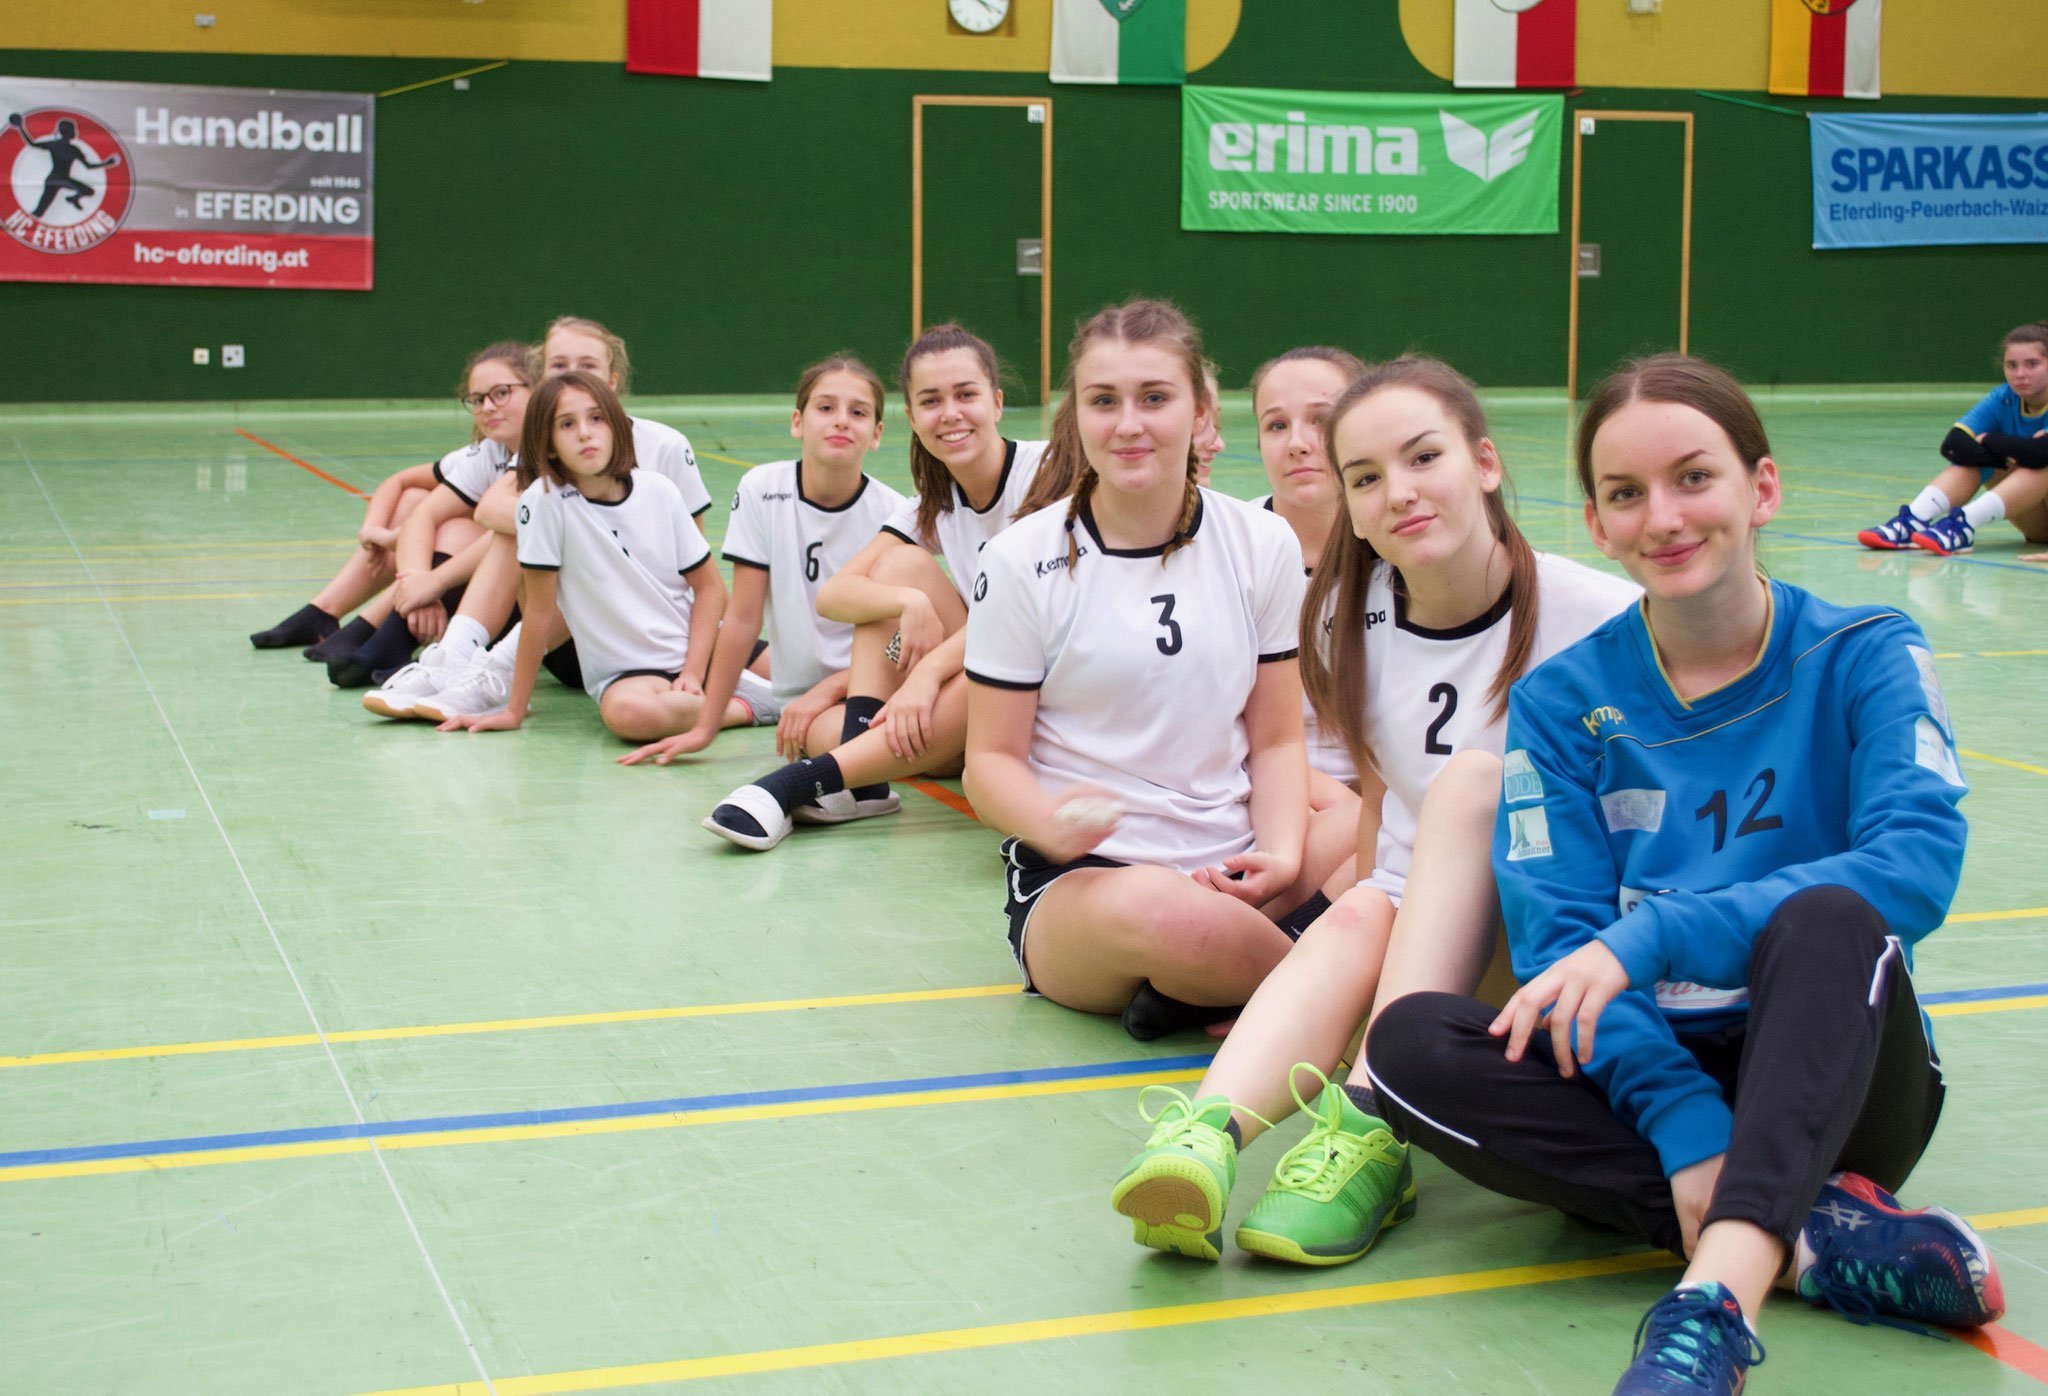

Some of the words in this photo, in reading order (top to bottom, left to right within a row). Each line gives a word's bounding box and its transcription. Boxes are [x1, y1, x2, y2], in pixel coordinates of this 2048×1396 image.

[136, 107, 362, 153] Handball
[1208, 111, 1418, 175] erima
[175, 204, 189, 218] in
[195, 191, 360, 224] EFERDING
[1208, 190, 1320, 212] SPORTSWEAR
[1324, 193, 1373, 213] SINCE
[1377, 194, 1419, 214] 1900
[5, 209, 33, 238] HC
[32, 210, 116, 251] EFERDING
[134, 242, 309, 272] hc-eferding.at
[805, 541, 823, 582] 6
[1034, 545, 1088, 578] Kema
[1151, 593, 1183, 656] 3
[1424, 682, 1458, 755] 2
[1695, 768, 1783, 854] 12
